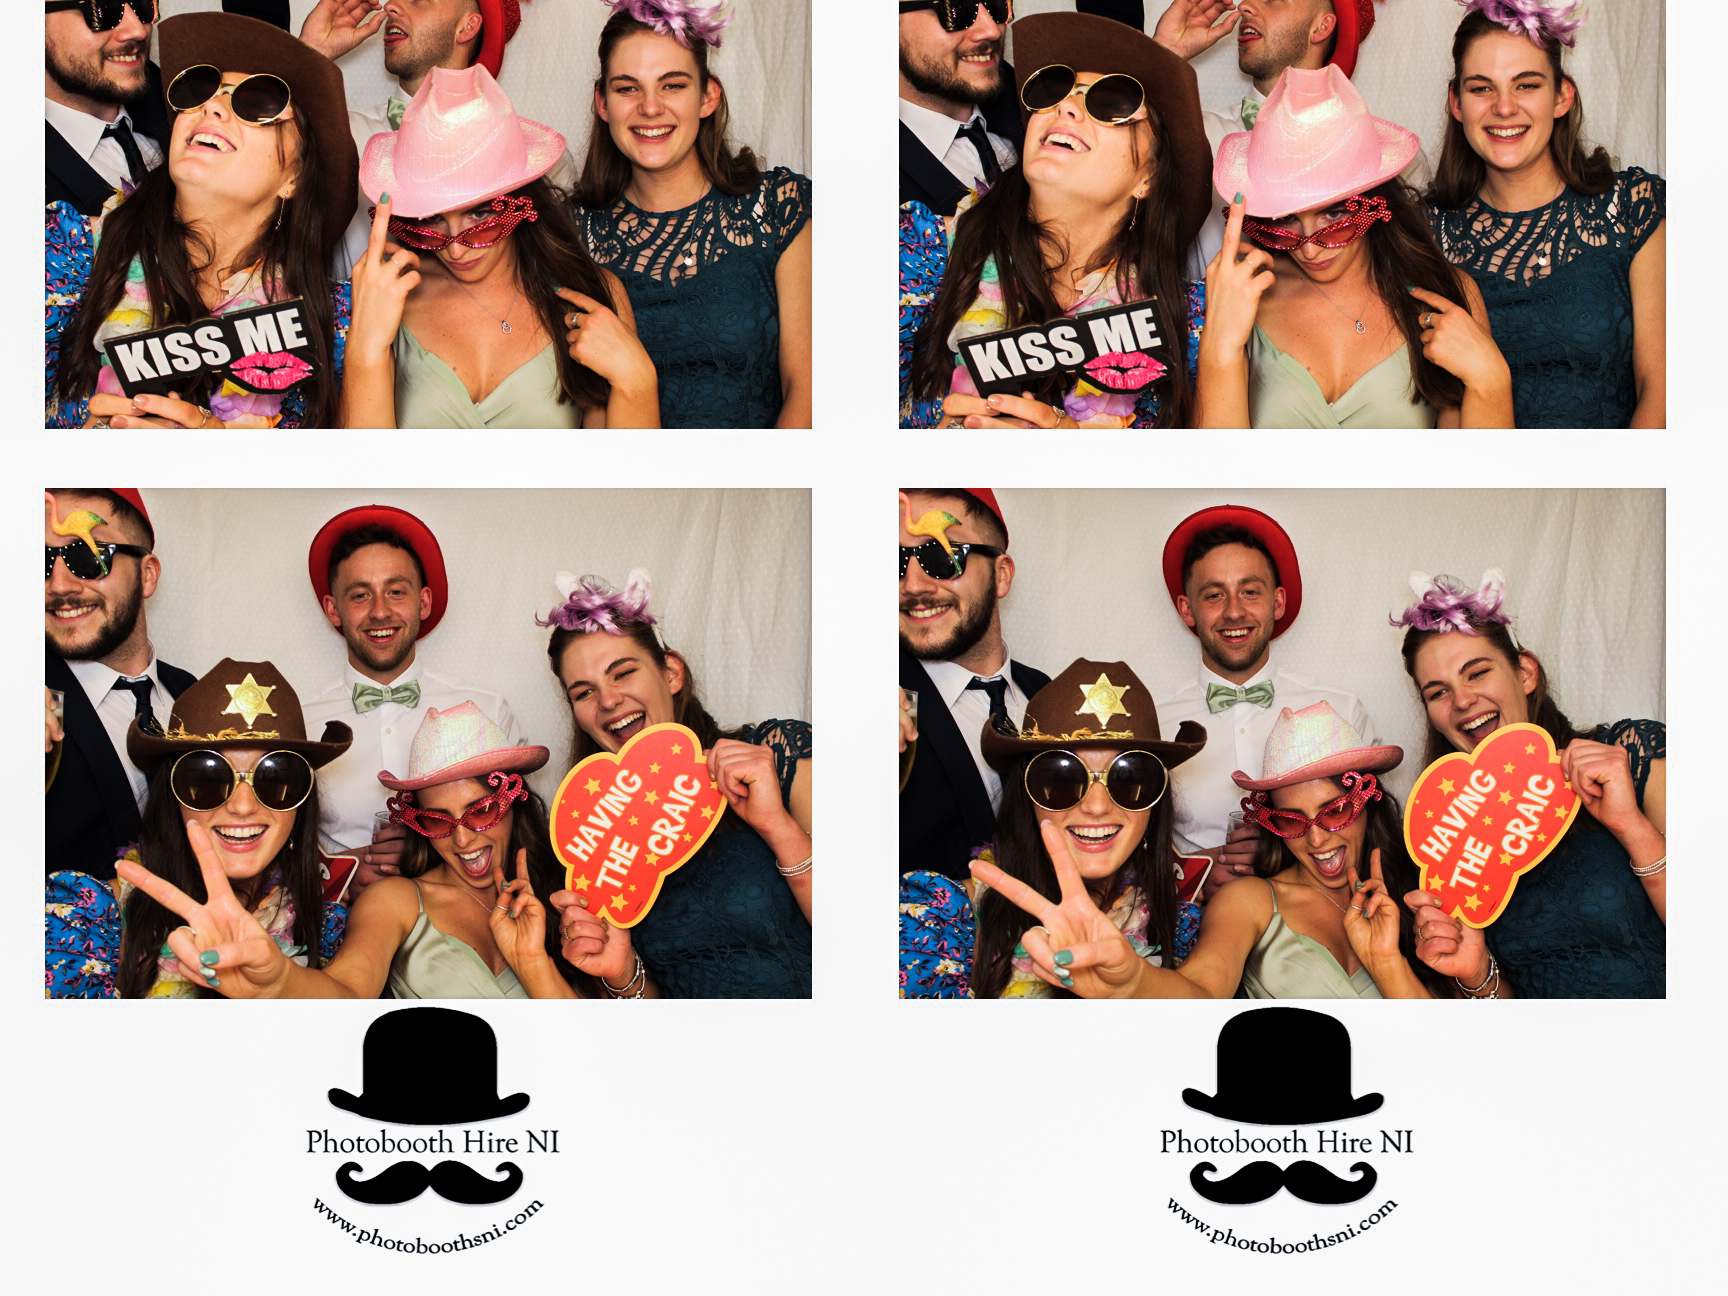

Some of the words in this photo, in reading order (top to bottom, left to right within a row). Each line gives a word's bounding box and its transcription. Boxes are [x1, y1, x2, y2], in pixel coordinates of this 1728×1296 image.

[114, 325, 231, 383] KISS
[233, 307, 308, 357] ME
[968, 325, 1085, 383] KISS
[1087, 307, 1162, 357] ME
[565, 769, 643, 863] HAVING
[594, 835, 640, 889] THE
[647, 774, 701, 856] CRAIC
[1419, 769, 1497, 863] HAVING
[1448, 835, 1494, 889] THE
[1501, 774, 1555, 856] CRAIC
